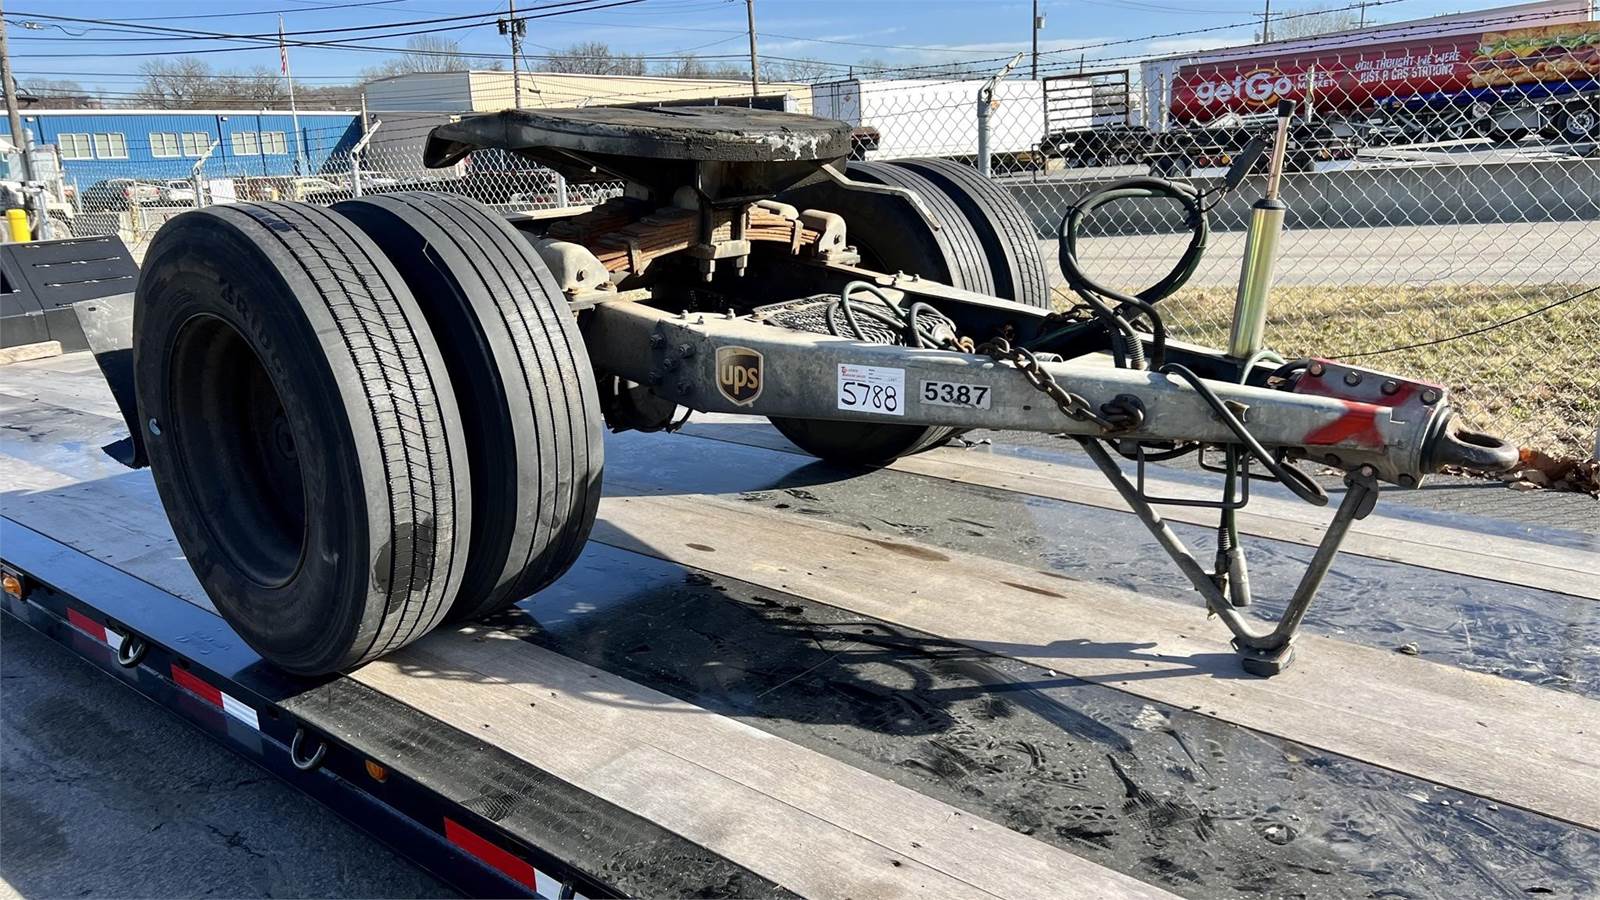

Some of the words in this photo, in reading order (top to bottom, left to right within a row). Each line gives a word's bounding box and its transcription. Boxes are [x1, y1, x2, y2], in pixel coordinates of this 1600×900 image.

[1355, 60, 1374, 71] YOU
[1375, 56, 1415, 70] THOUGHT
[1417, 55, 1432, 66] WE
[1434, 51, 1461, 63] WERE
[1297, 71, 1325, 82] CFE
[1360, 70, 1380, 83] JUST
[1382, 70, 1389, 81] A
[1391, 68, 1409, 80] GAS
[1411, 63, 1455, 79] STATION?
[1196, 73, 1293, 106] getGo
[1297, 79, 1334, 90] MRKET
[721, 366, 759, 395] ups
[841, 381, 897, 412] 5788
[924, 382, 989, 405] 5387
